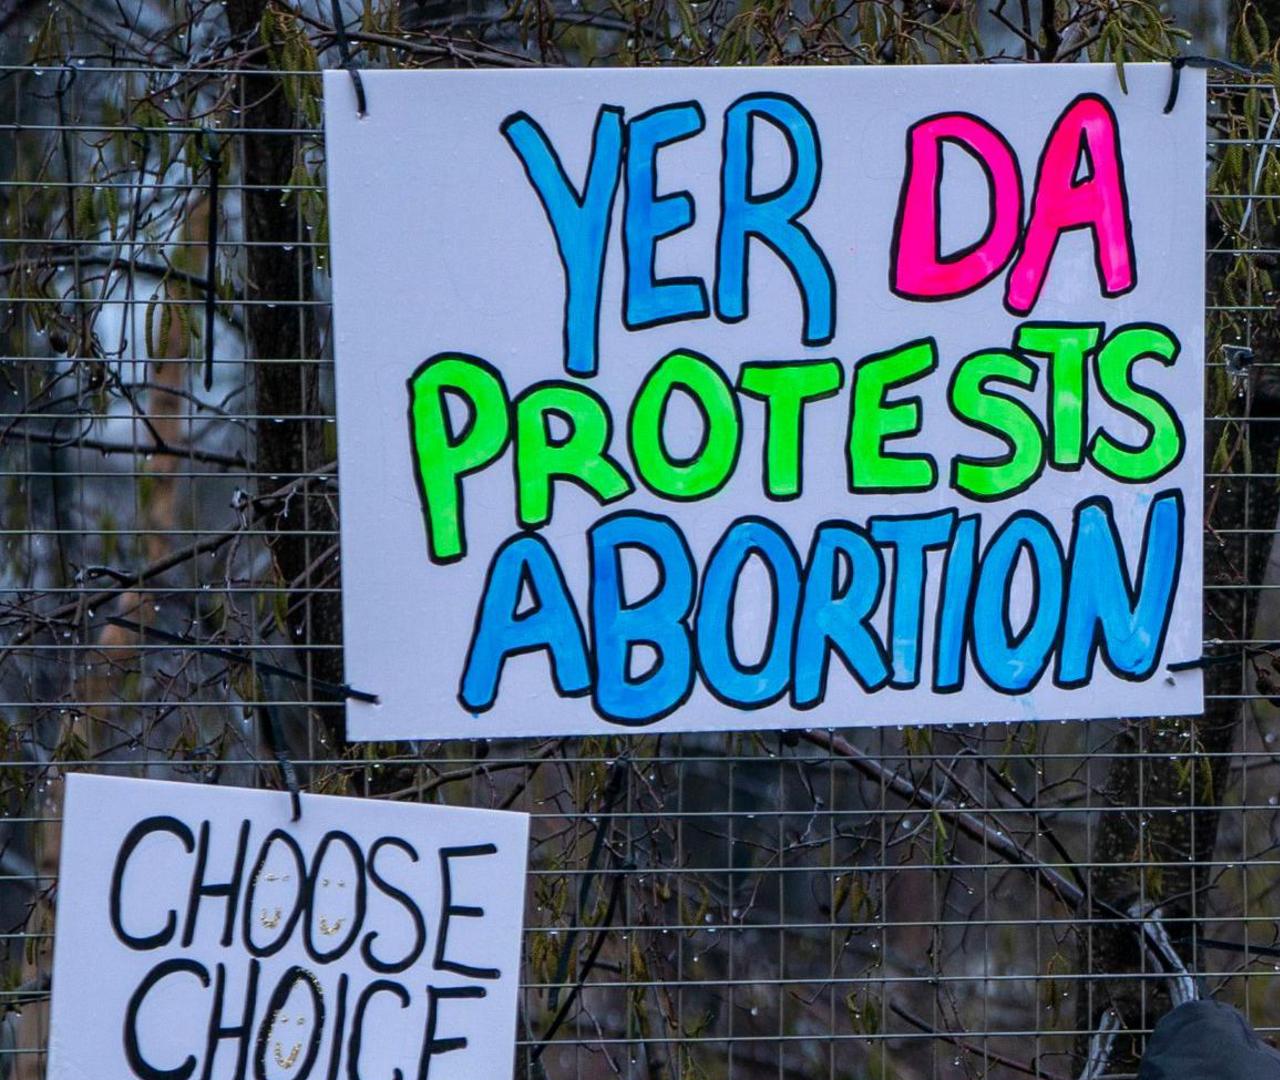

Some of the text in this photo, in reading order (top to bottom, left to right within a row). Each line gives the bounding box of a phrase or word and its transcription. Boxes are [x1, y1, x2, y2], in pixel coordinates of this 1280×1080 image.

[500, 92, 1136, 376] YER DA
[409, 321, 1185, 564] PROTESTS
[459, 488, 1183, 724] ABORTION
[108, 815, 501, 979] CHOOSE
